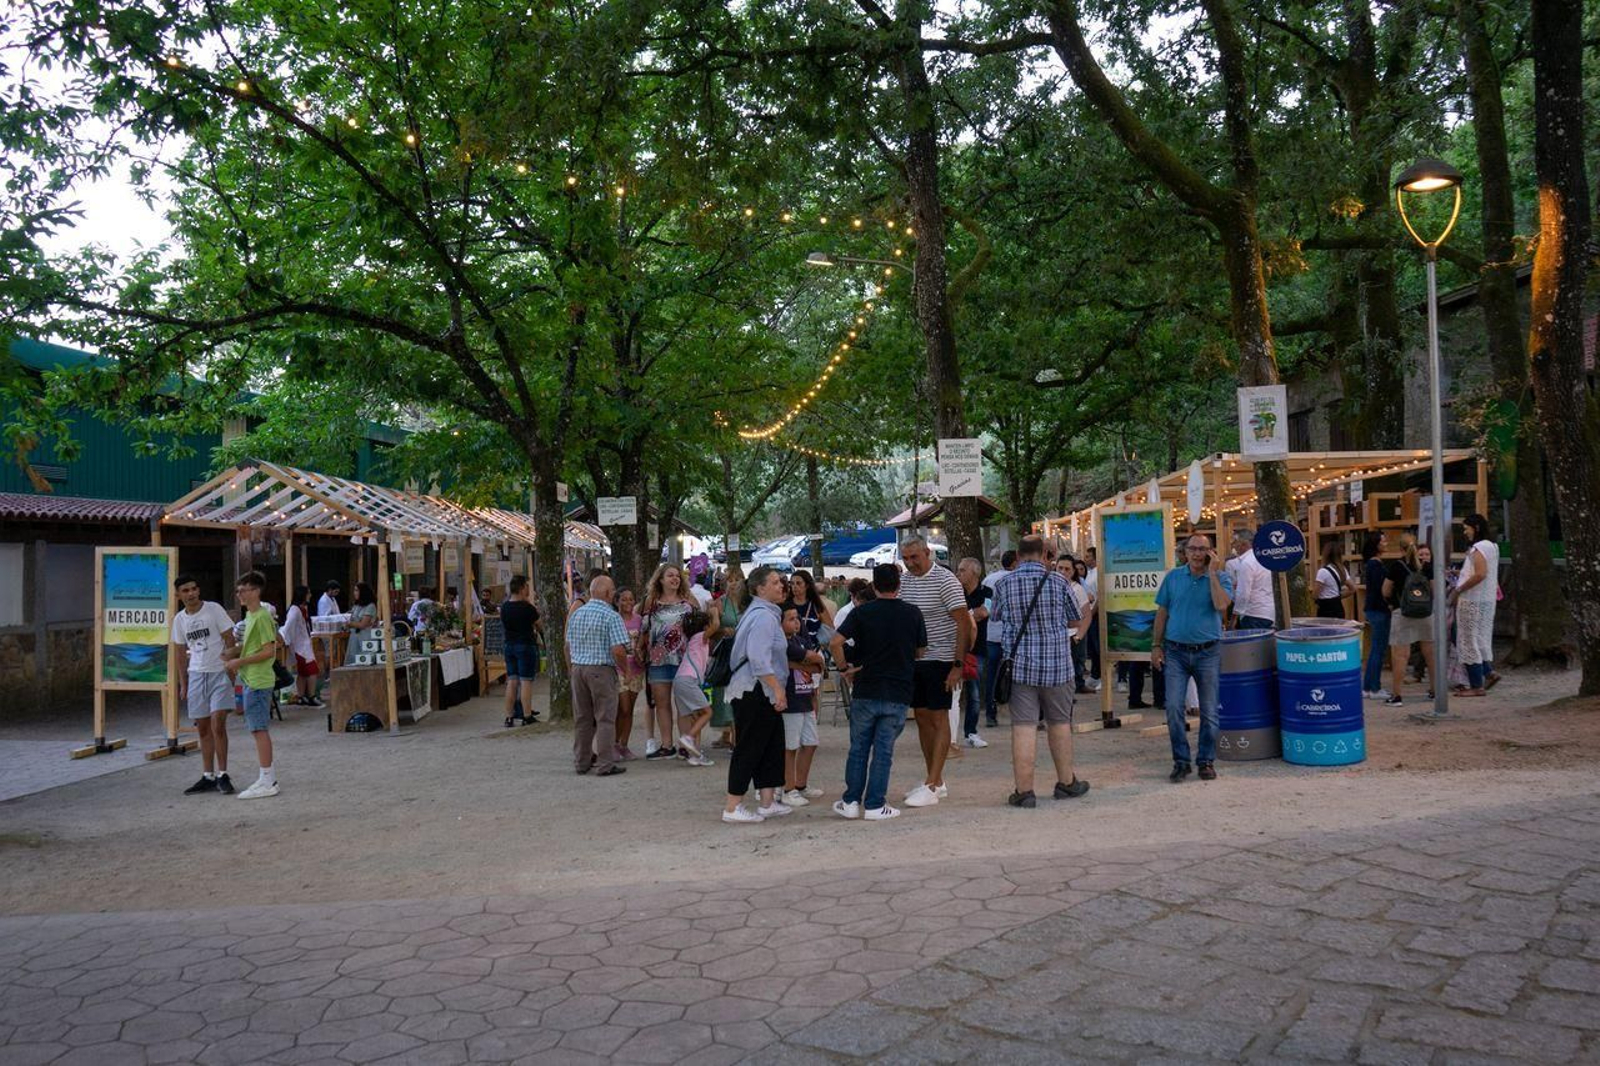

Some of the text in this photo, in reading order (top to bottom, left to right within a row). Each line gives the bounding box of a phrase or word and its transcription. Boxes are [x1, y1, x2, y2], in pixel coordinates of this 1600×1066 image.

[1114, 574, 1158, 589] ADEGAS
[108, 610, 165, 624] MERCADO
[1285, 652, 1308, 663] PAPEL
[1316, 650, 1348, 662] CARTÓN
